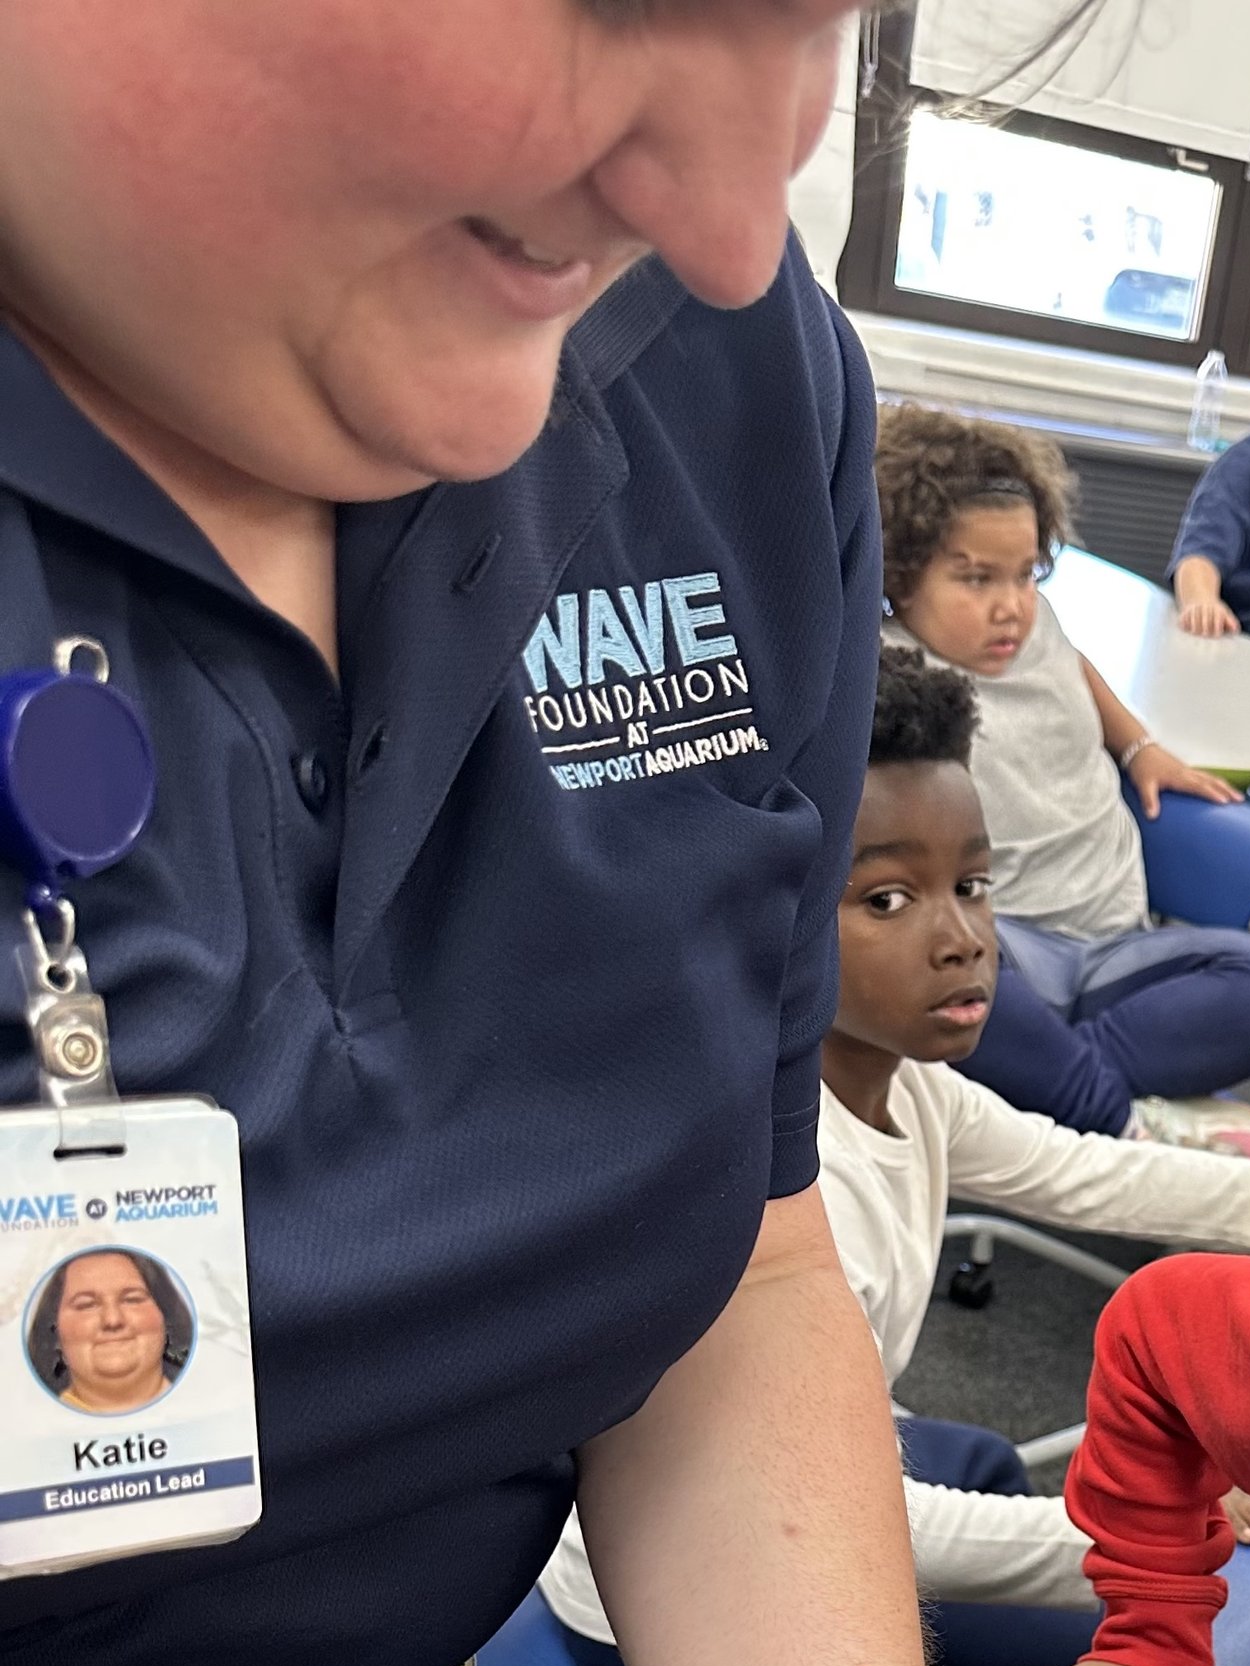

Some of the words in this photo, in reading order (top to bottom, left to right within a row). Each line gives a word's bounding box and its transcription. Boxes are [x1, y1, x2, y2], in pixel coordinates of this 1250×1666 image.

[524, 659, 749, 733] FOUNDATION
[627, 721, 650, 749] AT
[115, 1184, 216, 1206] NEWPORT
[0, 1218, 80, 1233] UNDATION
[115, 1201, 218, 1223] AQUARIUM
[74, 1433, 168, 1471] Katie
[44, 1480, 151, 1510] Education
[156, 1468, 206, 1494] Lead
